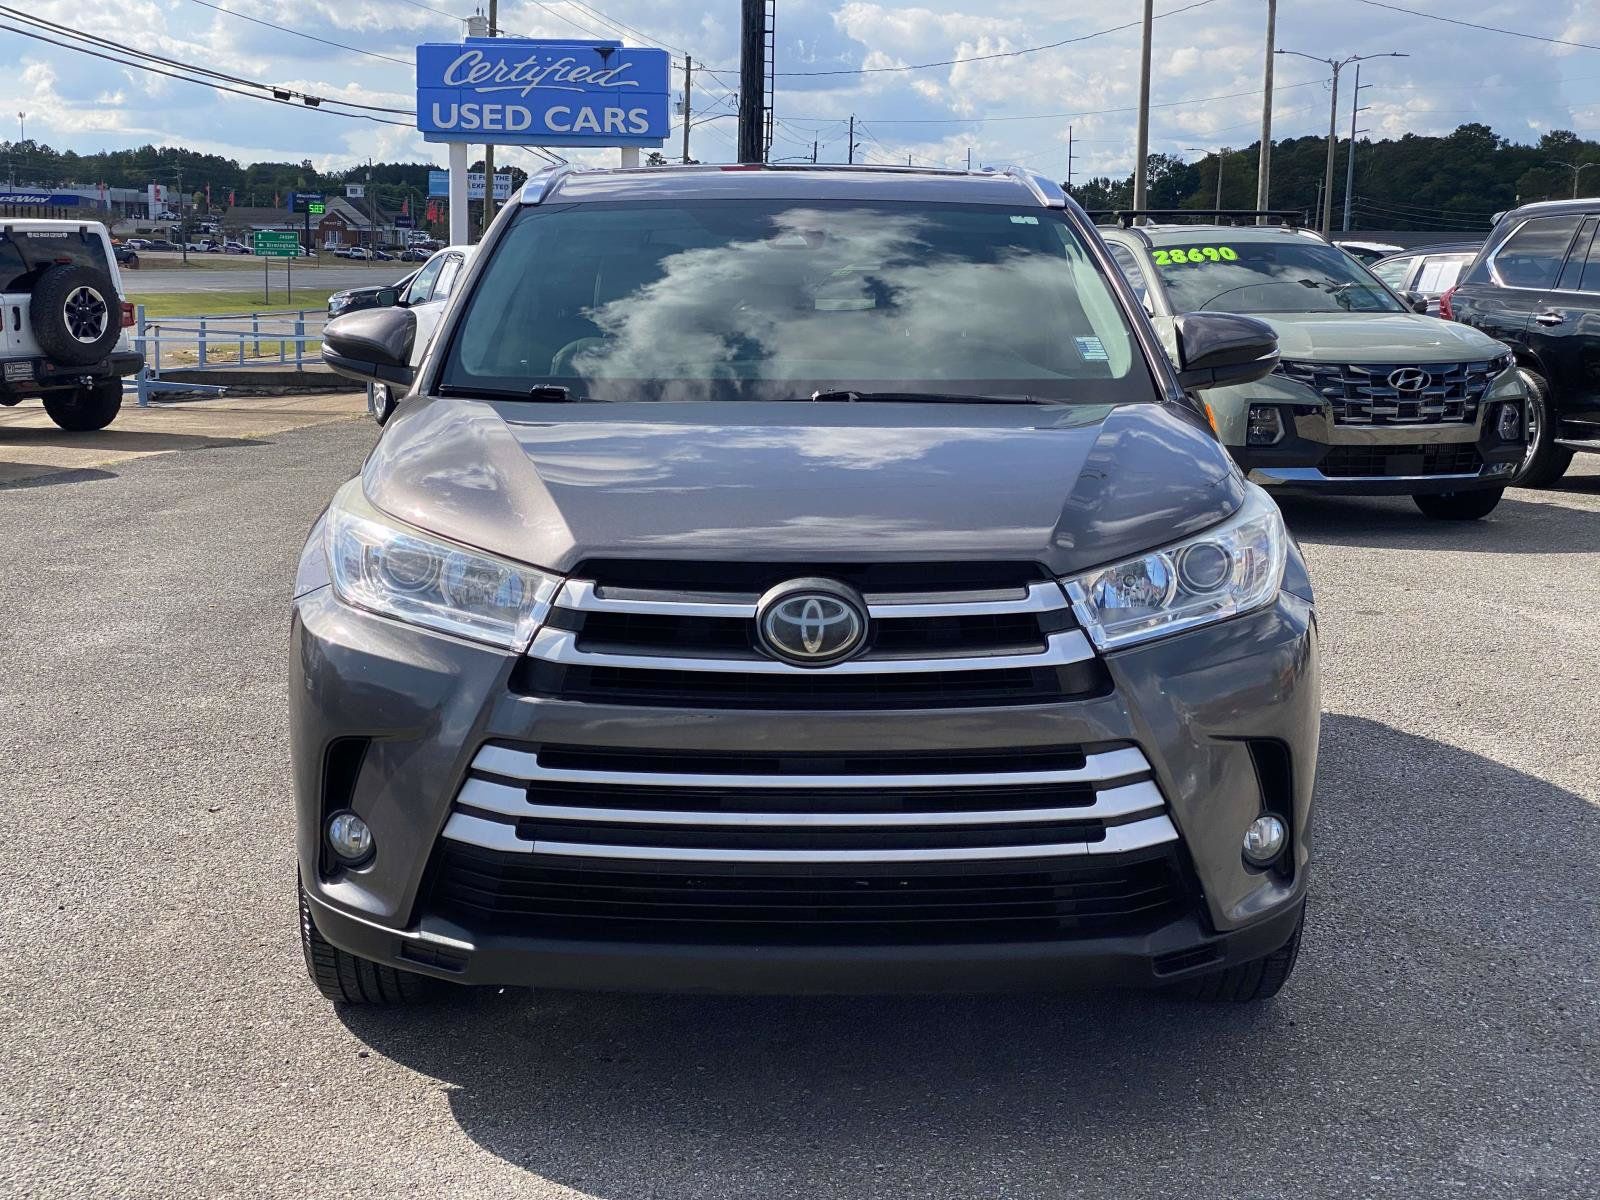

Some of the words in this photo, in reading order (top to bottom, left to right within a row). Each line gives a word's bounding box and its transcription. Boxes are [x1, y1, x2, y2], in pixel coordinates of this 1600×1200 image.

[443, 50, 639, 97] Certified
[432, 102, 532, 130] USED
[544, 105, 649, 134] CARS
[1152, 246, 1238, 266] 28690
